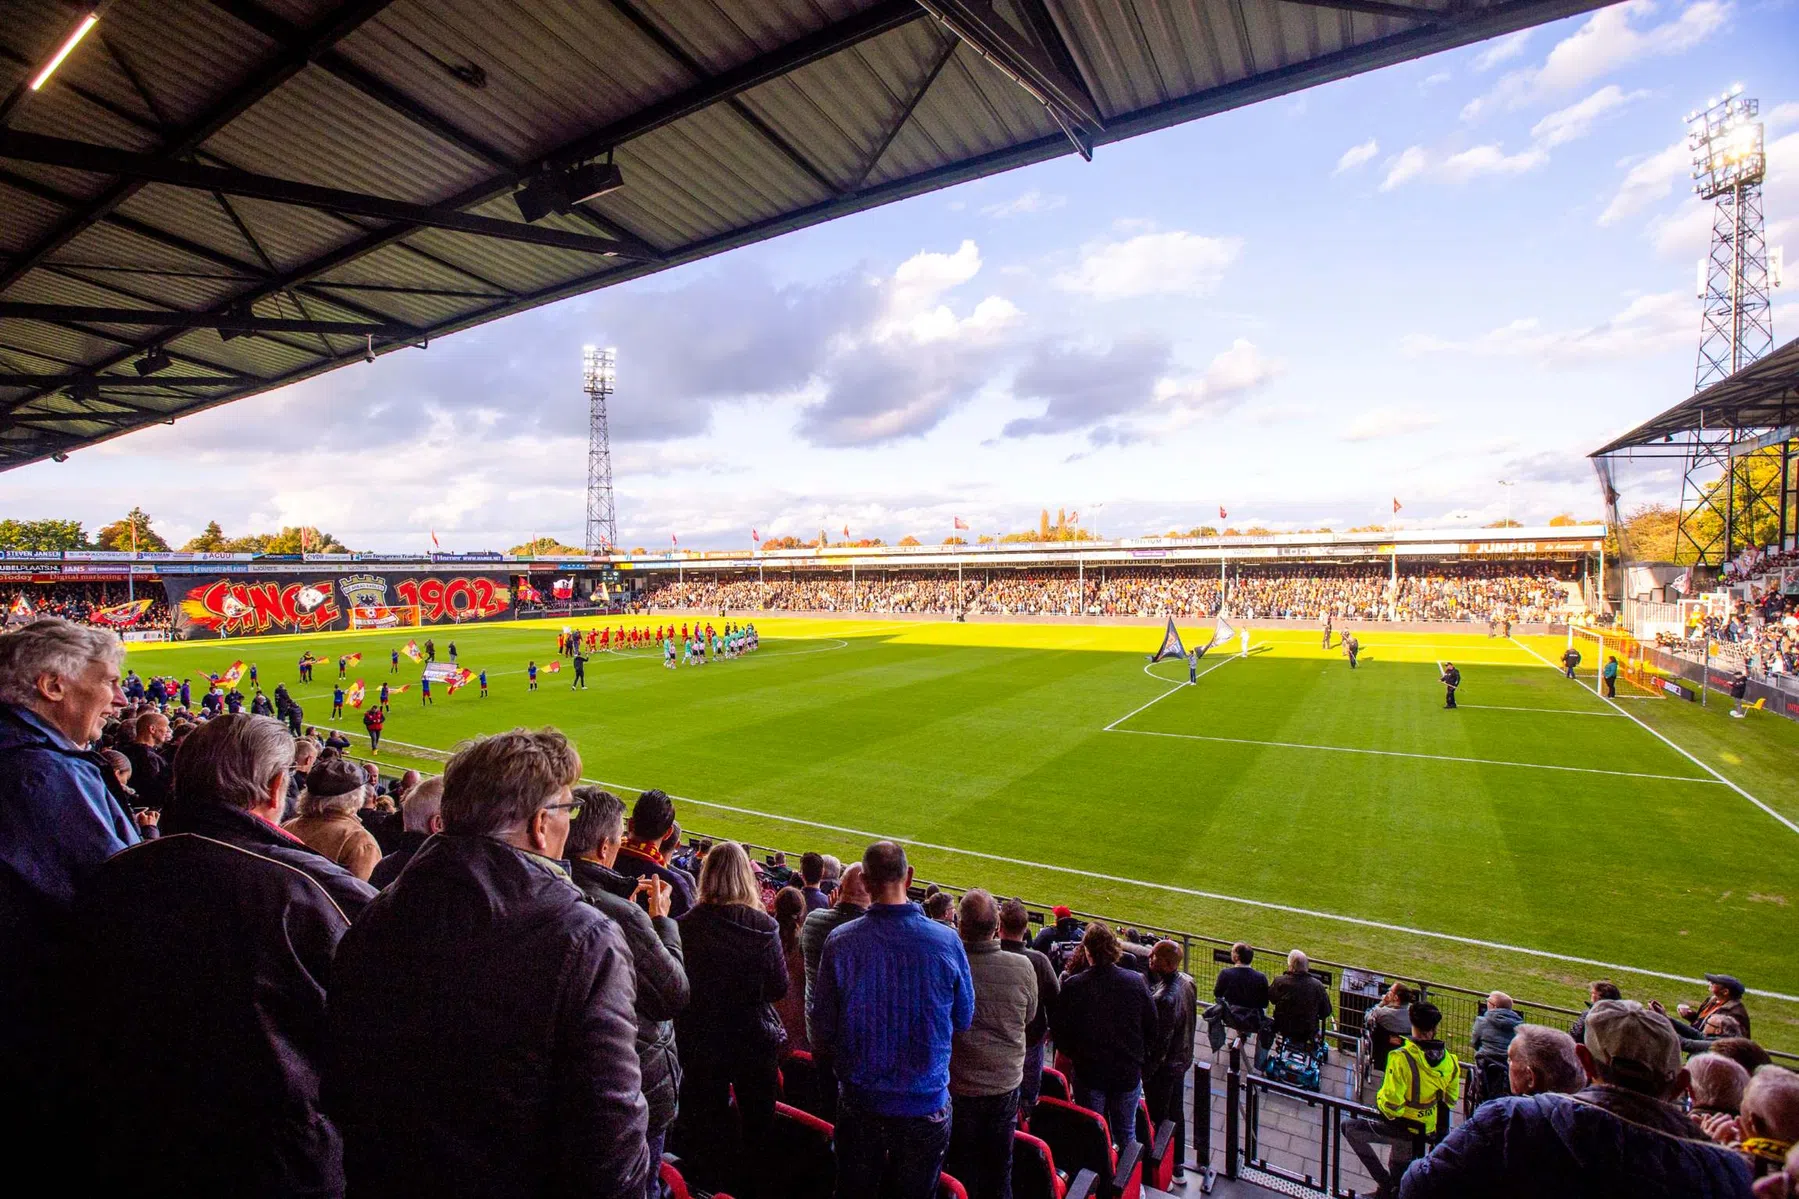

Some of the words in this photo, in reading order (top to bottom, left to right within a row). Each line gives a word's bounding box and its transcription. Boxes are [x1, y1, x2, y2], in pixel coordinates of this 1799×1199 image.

[1476, 542, 1537, 553] JUMPER
[50, 574, 79, 582] Digital
[203, 578, 341, 633] SINCE
[394, 577, 498, 625] 1902
